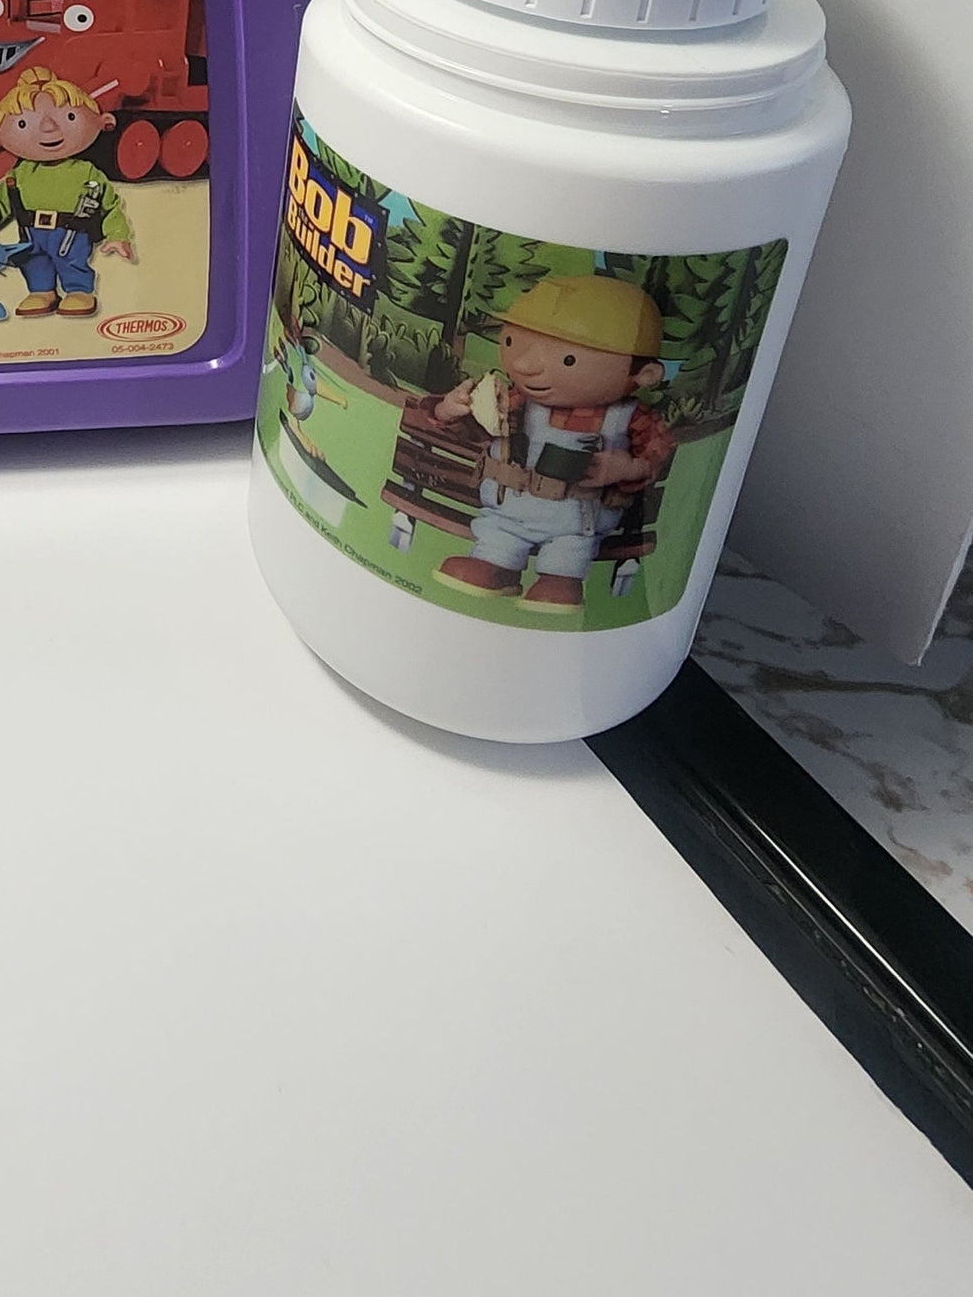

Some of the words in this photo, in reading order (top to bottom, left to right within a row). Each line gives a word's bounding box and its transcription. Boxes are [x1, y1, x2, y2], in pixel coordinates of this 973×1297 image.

[288, 134, 373, 264] Bob
[287, 197, 371, 298] Builder
[37, 348, 59, 356] 2001
[115, 319, 169, 334] THERMOS
[344, 543, 393, 581] Chapman
[394, 574, 423, 594] 2002
